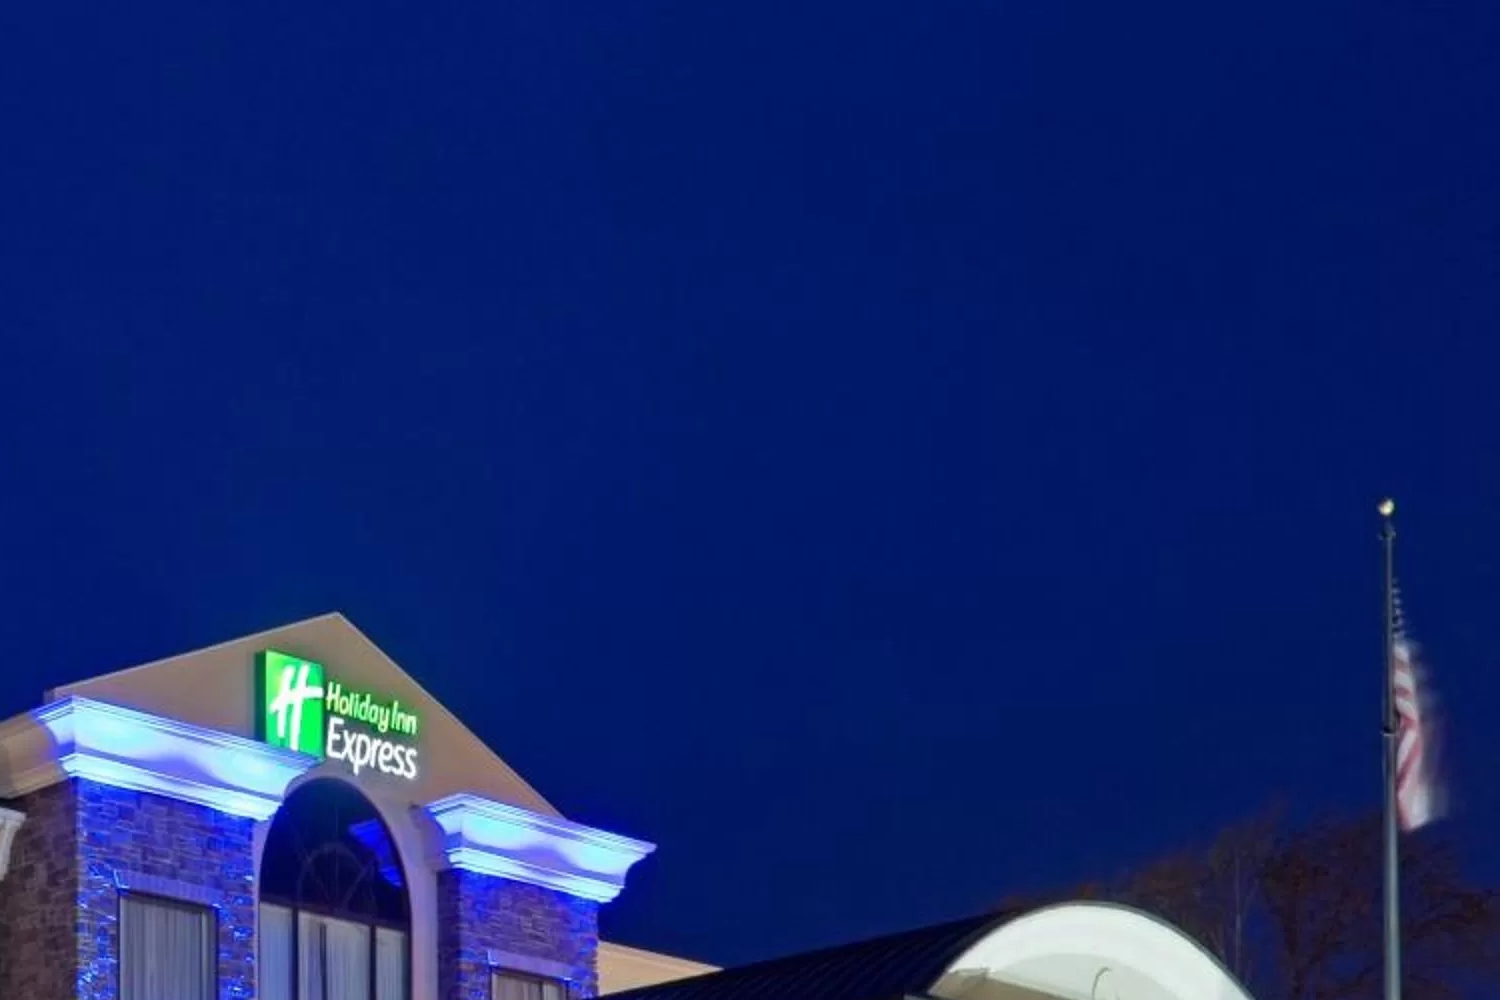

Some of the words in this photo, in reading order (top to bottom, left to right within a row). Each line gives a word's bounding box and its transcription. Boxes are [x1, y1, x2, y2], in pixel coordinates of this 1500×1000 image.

[326, 681, 390, 733] Holiday
[391, 700, 417, 735] Inn
[327, 716, 418, 778] Express
